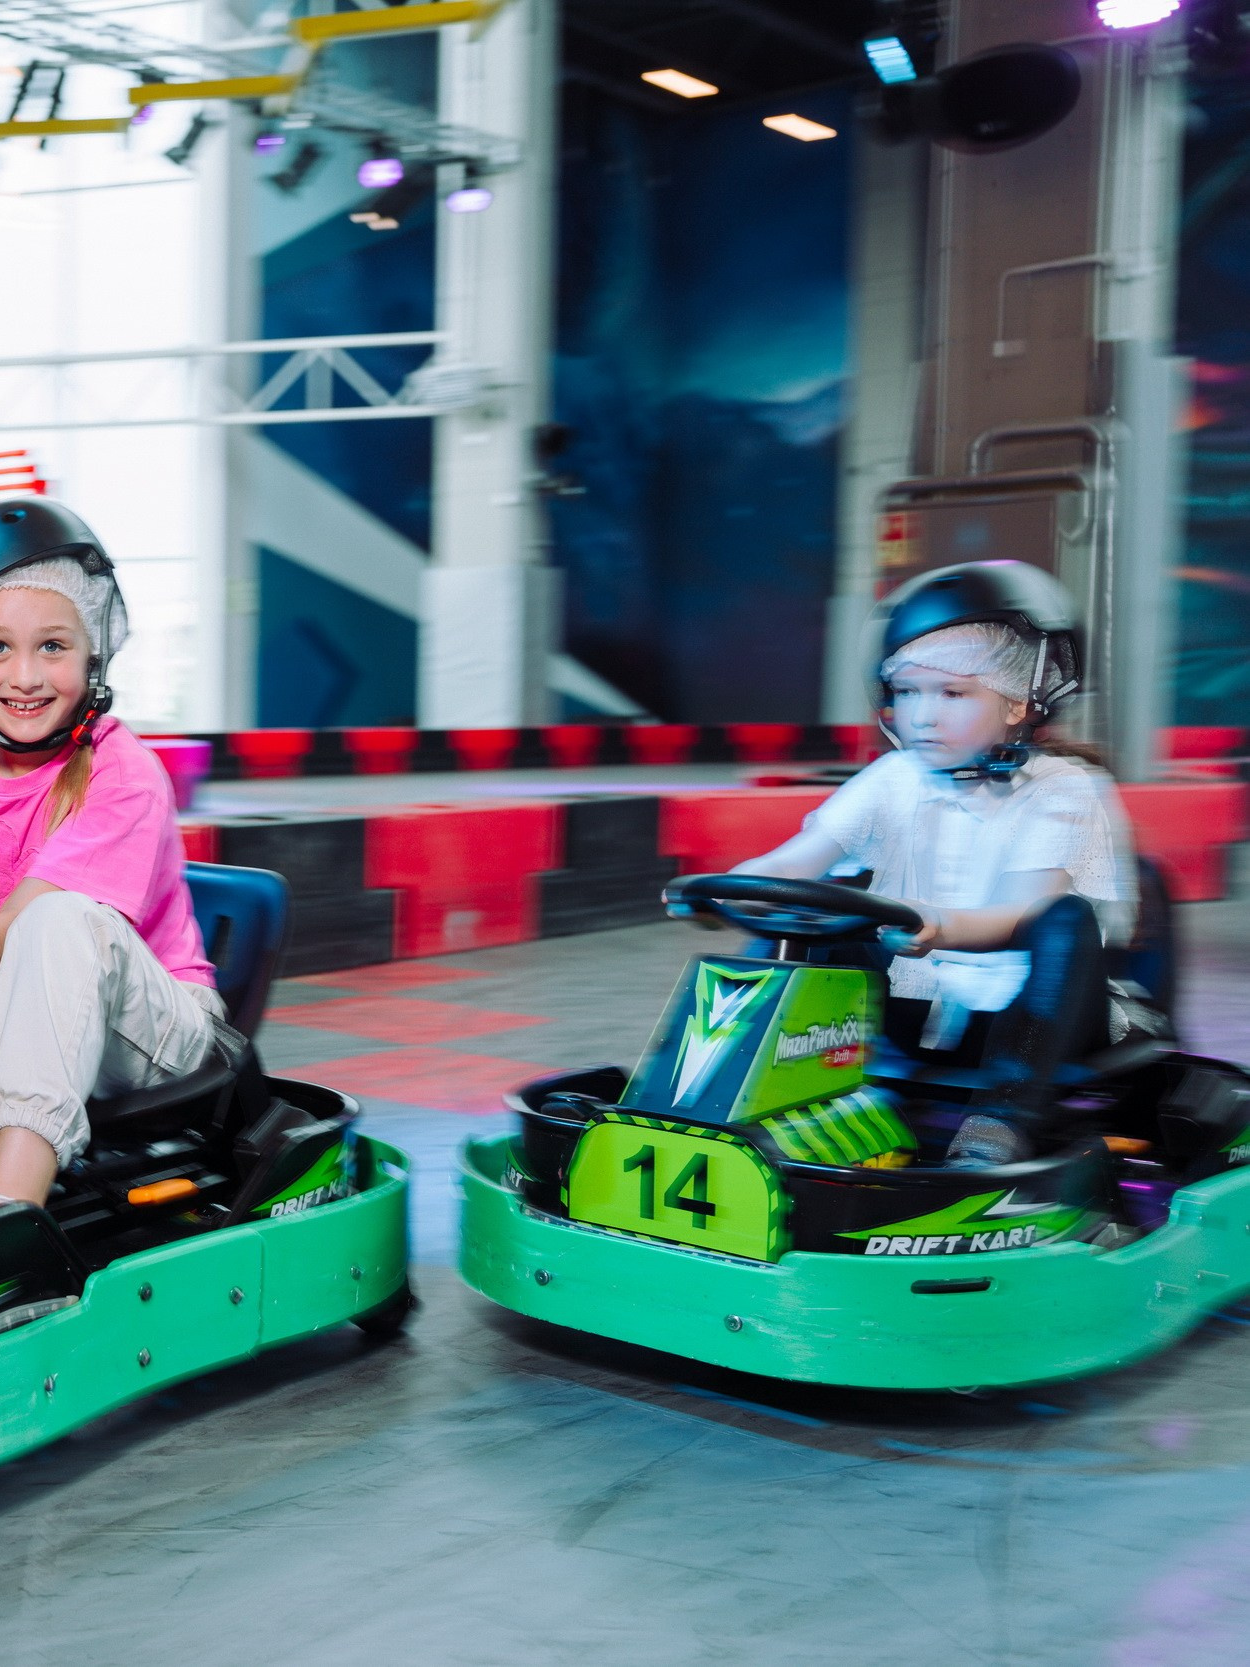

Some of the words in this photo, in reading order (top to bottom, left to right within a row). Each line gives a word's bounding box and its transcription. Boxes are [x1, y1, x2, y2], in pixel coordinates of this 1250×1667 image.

[270, 1185, 325, 1218] DRIFT
[623, 1144, 716, 1230] 14
[864, 1234, 964, 1256] DRIFT
[968, 1224, 1037, 1253] KART
